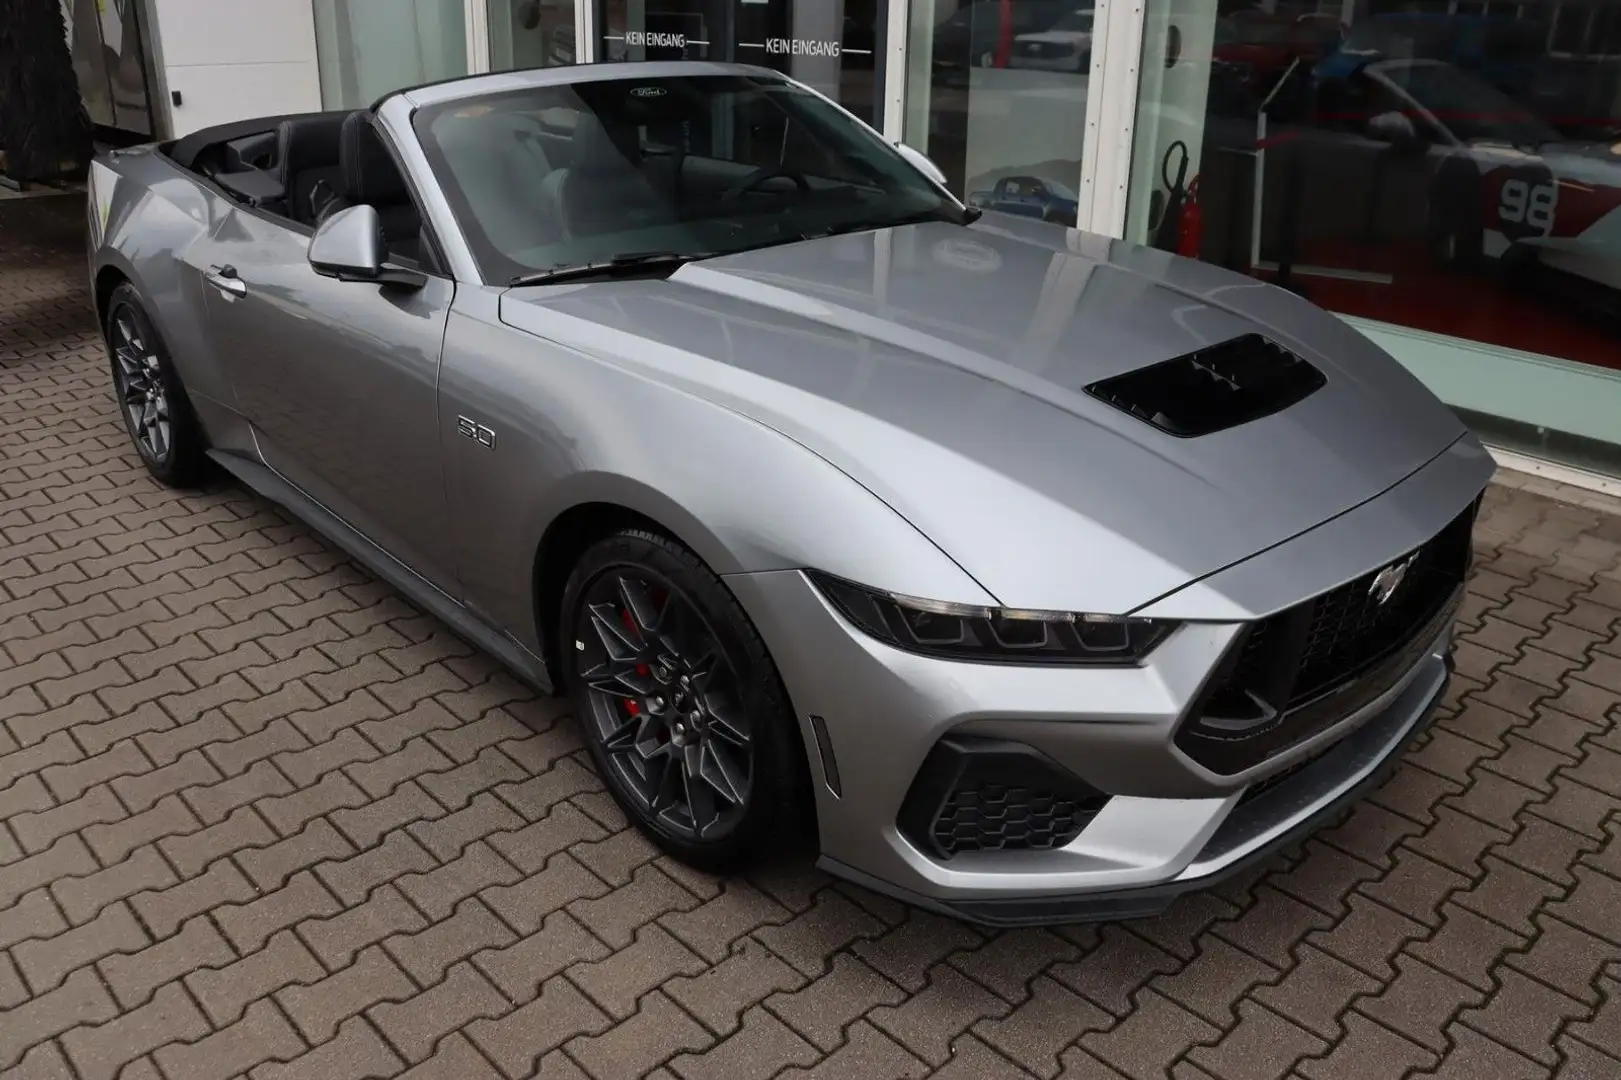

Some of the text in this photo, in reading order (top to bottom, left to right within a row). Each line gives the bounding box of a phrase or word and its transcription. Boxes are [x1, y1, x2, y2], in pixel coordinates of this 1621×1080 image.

[626, 32, 685, 47] KEIN EINGANG
[766, 38, 839, 57] KEIN EINGANG
[1498, 179, 1557, 233] 98
